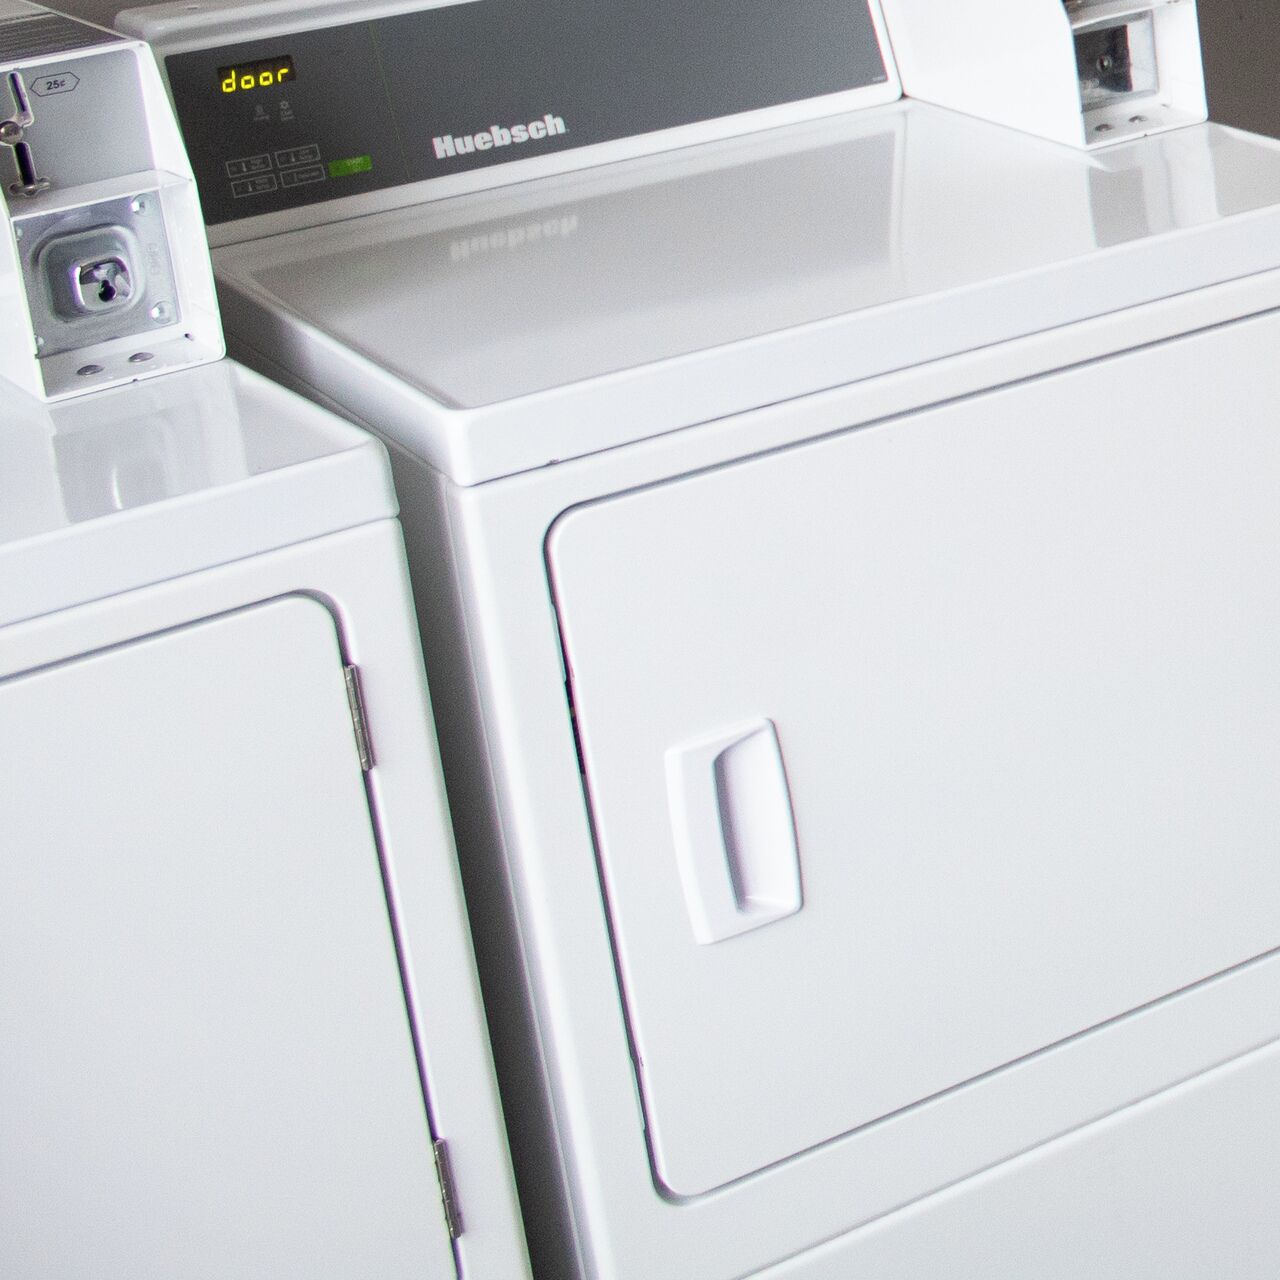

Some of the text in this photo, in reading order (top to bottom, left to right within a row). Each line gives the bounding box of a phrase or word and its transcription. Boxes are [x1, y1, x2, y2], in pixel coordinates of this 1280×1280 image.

[45, 76, 67, 92] 25¢
[220, 66, 290, 94] door
[431, 114, 567, 160] Huebsch
